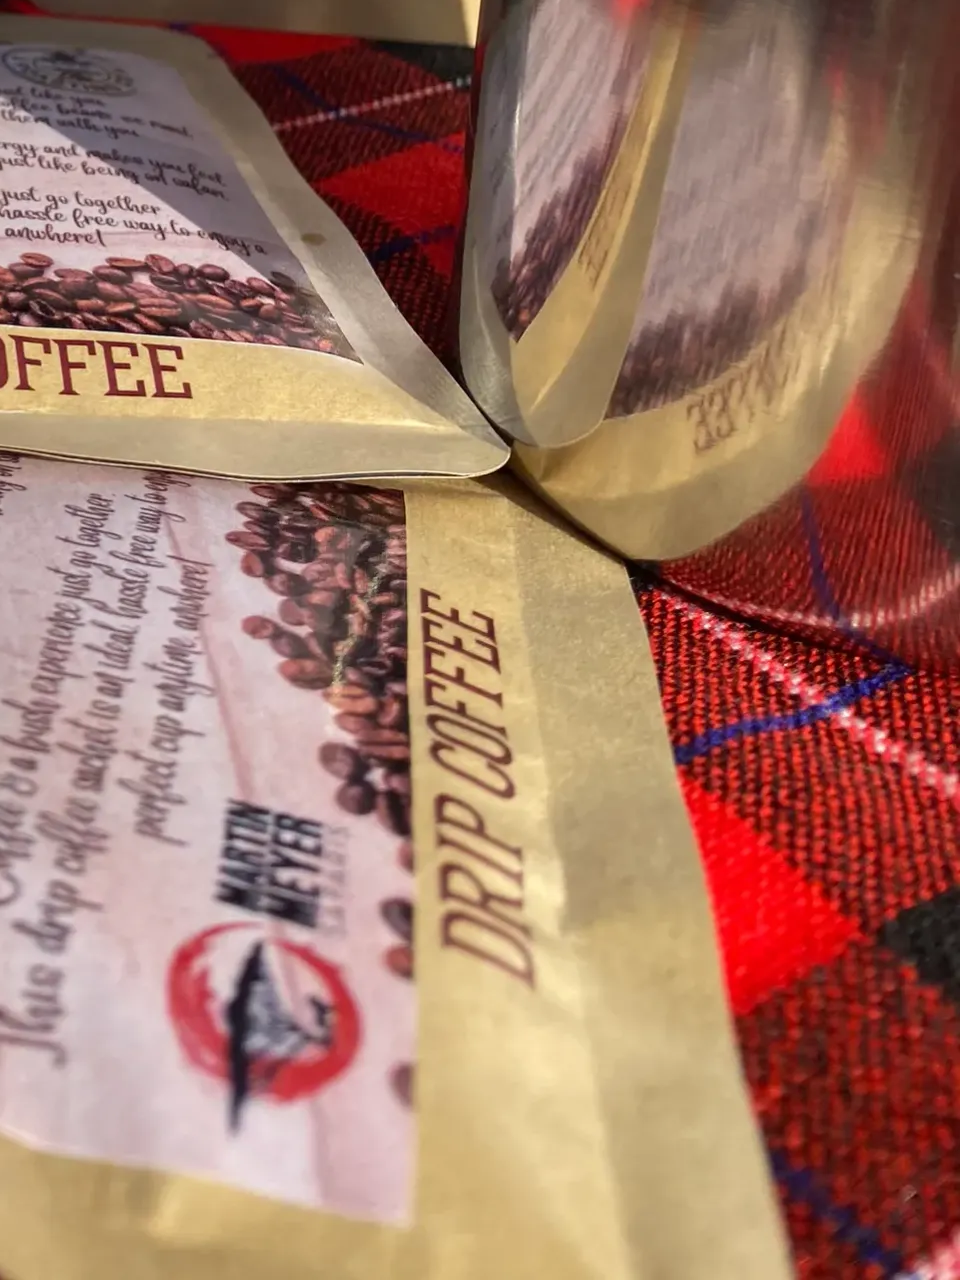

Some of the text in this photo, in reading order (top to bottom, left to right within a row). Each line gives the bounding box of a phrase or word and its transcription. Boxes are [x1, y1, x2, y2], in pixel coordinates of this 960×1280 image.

[37, 154, 78, 173] like
[80, 161, 141, 185] being
[144, 172, 168, 186] on
[43, 143, 82, 158] and
[85, 147, 145, 166] makes
[147, 158, 187, 176] you
[0, 186, 41, 206] just
[45, 193, 70, 211] go
[72, 207, 119, 229] free
[123, 219, 167, 241] way
[170, 220, 191, 237] to
[197, 230, 253, 257] enjoy
[253, 243, 268, 256] a
[108, 534, 167, 568] free
[135, 505, 187, 534] way
[30, 601, 87, 696] experience
[54, 717, 119, 794] sachet
[150, 714, 206, 753] cup
[116, 749, 189, 847] perfect
[419, 586, 537, 990] DRIP COFFEE
[34, 796, 112, 876] coffee
[214, 797, 271, 911] MARTIN
[265, 812, 324, 929] MEYER
[10, 878, 105, 956] drip
